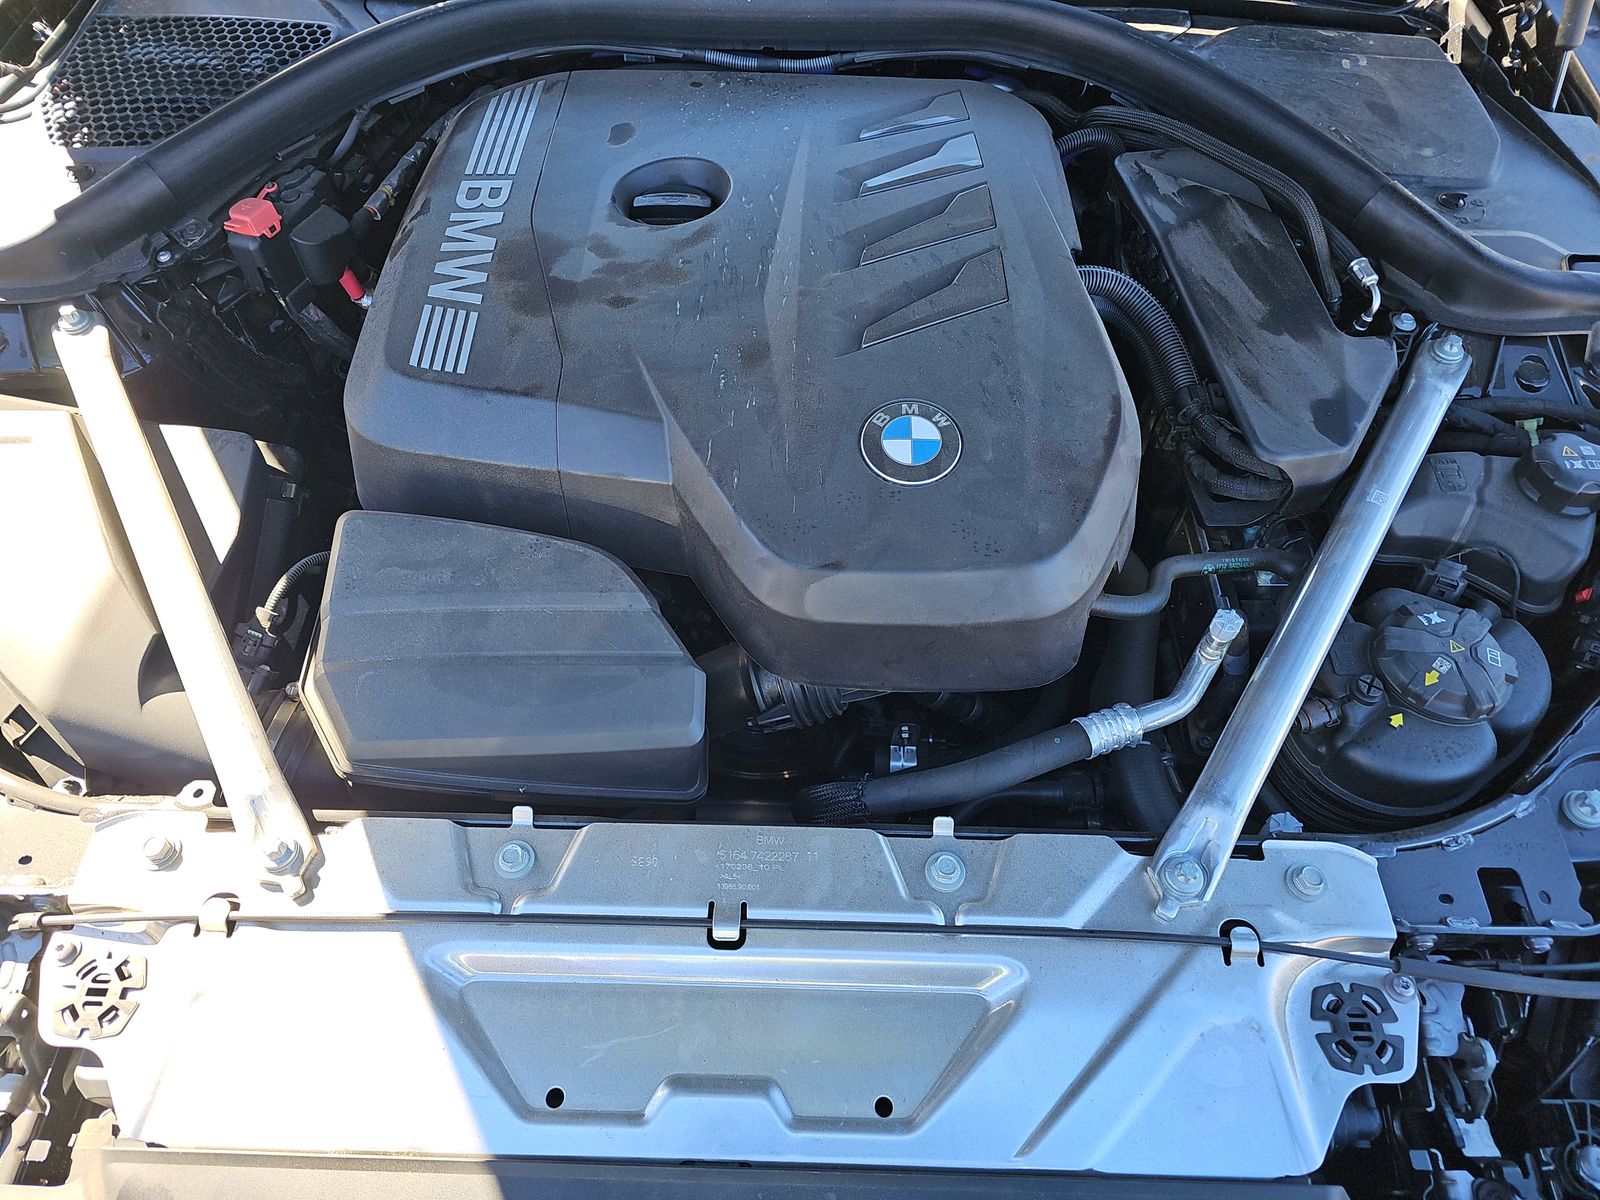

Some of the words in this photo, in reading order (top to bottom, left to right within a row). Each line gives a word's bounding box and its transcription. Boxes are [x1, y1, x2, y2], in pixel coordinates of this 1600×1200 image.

[427, 180, 513, 305] BMW
[872, 403, 951, 428] BMW
[756, 835, 785, 845] BMW
[719, 850, 748, 861] 5164
